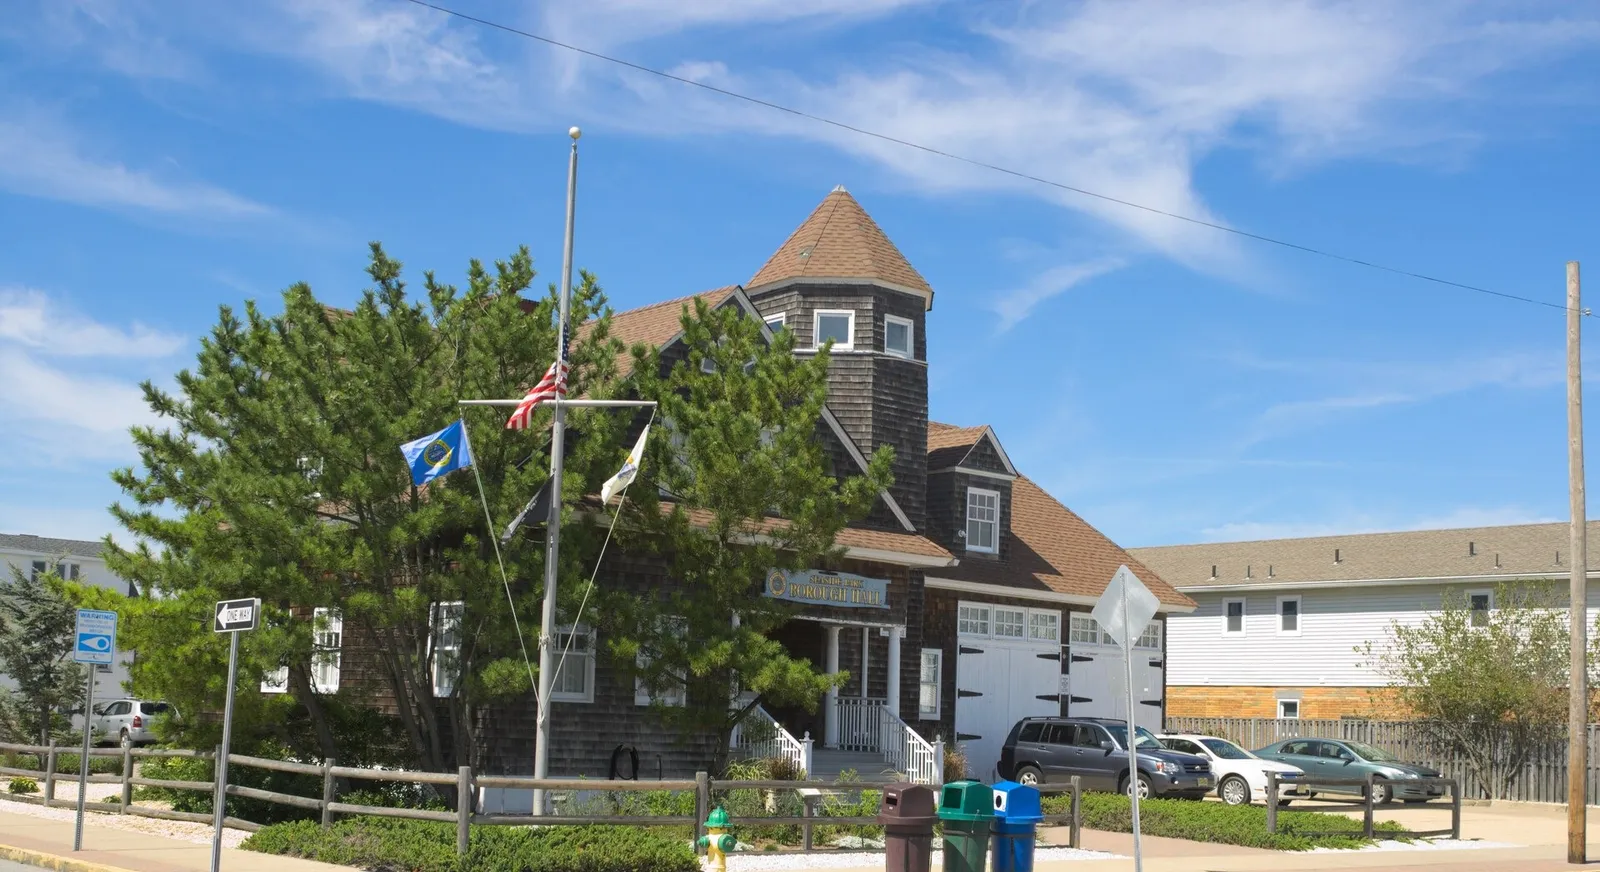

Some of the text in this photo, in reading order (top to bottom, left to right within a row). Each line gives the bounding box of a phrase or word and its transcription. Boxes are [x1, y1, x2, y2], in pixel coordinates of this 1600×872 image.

[809, 575, 864, 588] SEASIDE PARK
[789, 583, 847, 602] BOROUGH
[850, 589, 881, 605] HALL
[80, 612, 114, 620] WARNING
[227, 608, 251, 622] ONE WAY
